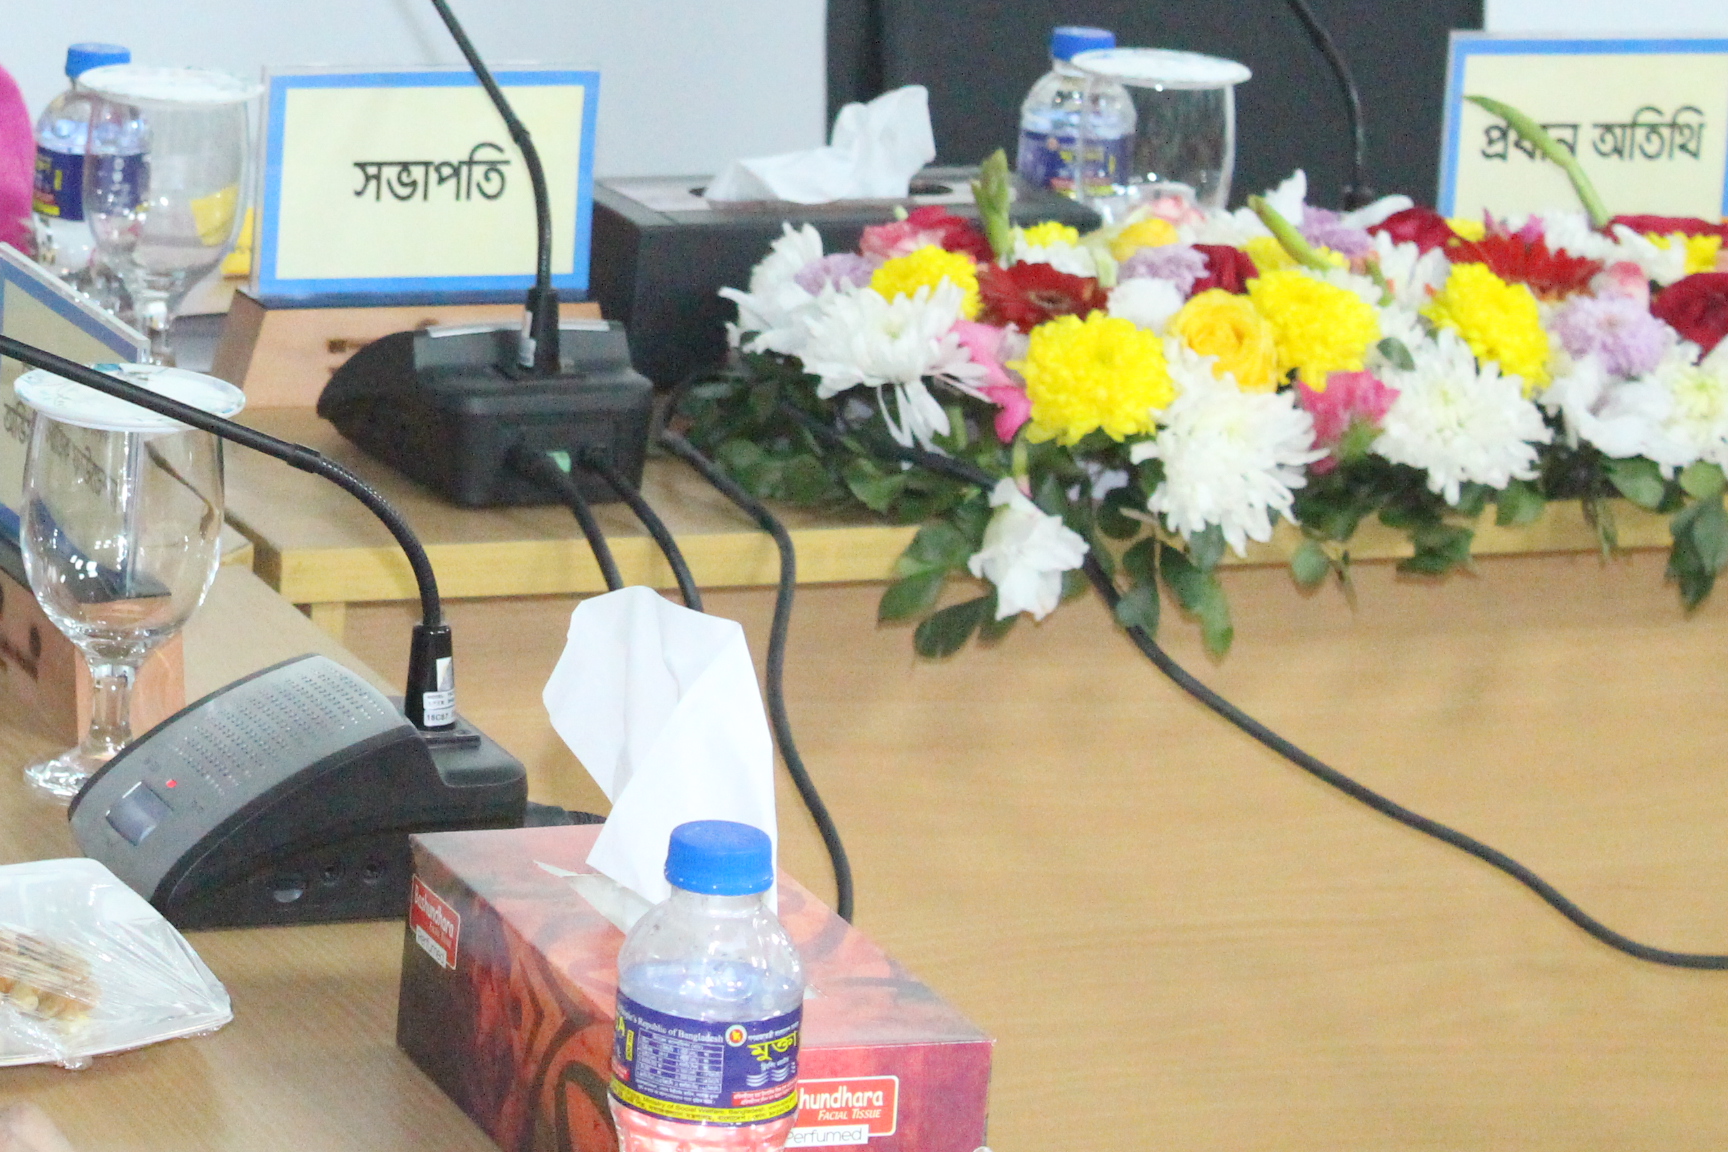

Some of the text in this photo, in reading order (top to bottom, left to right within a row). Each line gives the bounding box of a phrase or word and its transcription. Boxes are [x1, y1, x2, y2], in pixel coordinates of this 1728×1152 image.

[1481, 106, 1706, 162] প্রন অতিথি
[354, 142, 511, 202] সভাপতি
[668, 1028, 678, 1037] of
[678, 1028, 724, 1043] Bangladesh
[798, 1085, 883, 1109] hundhara
